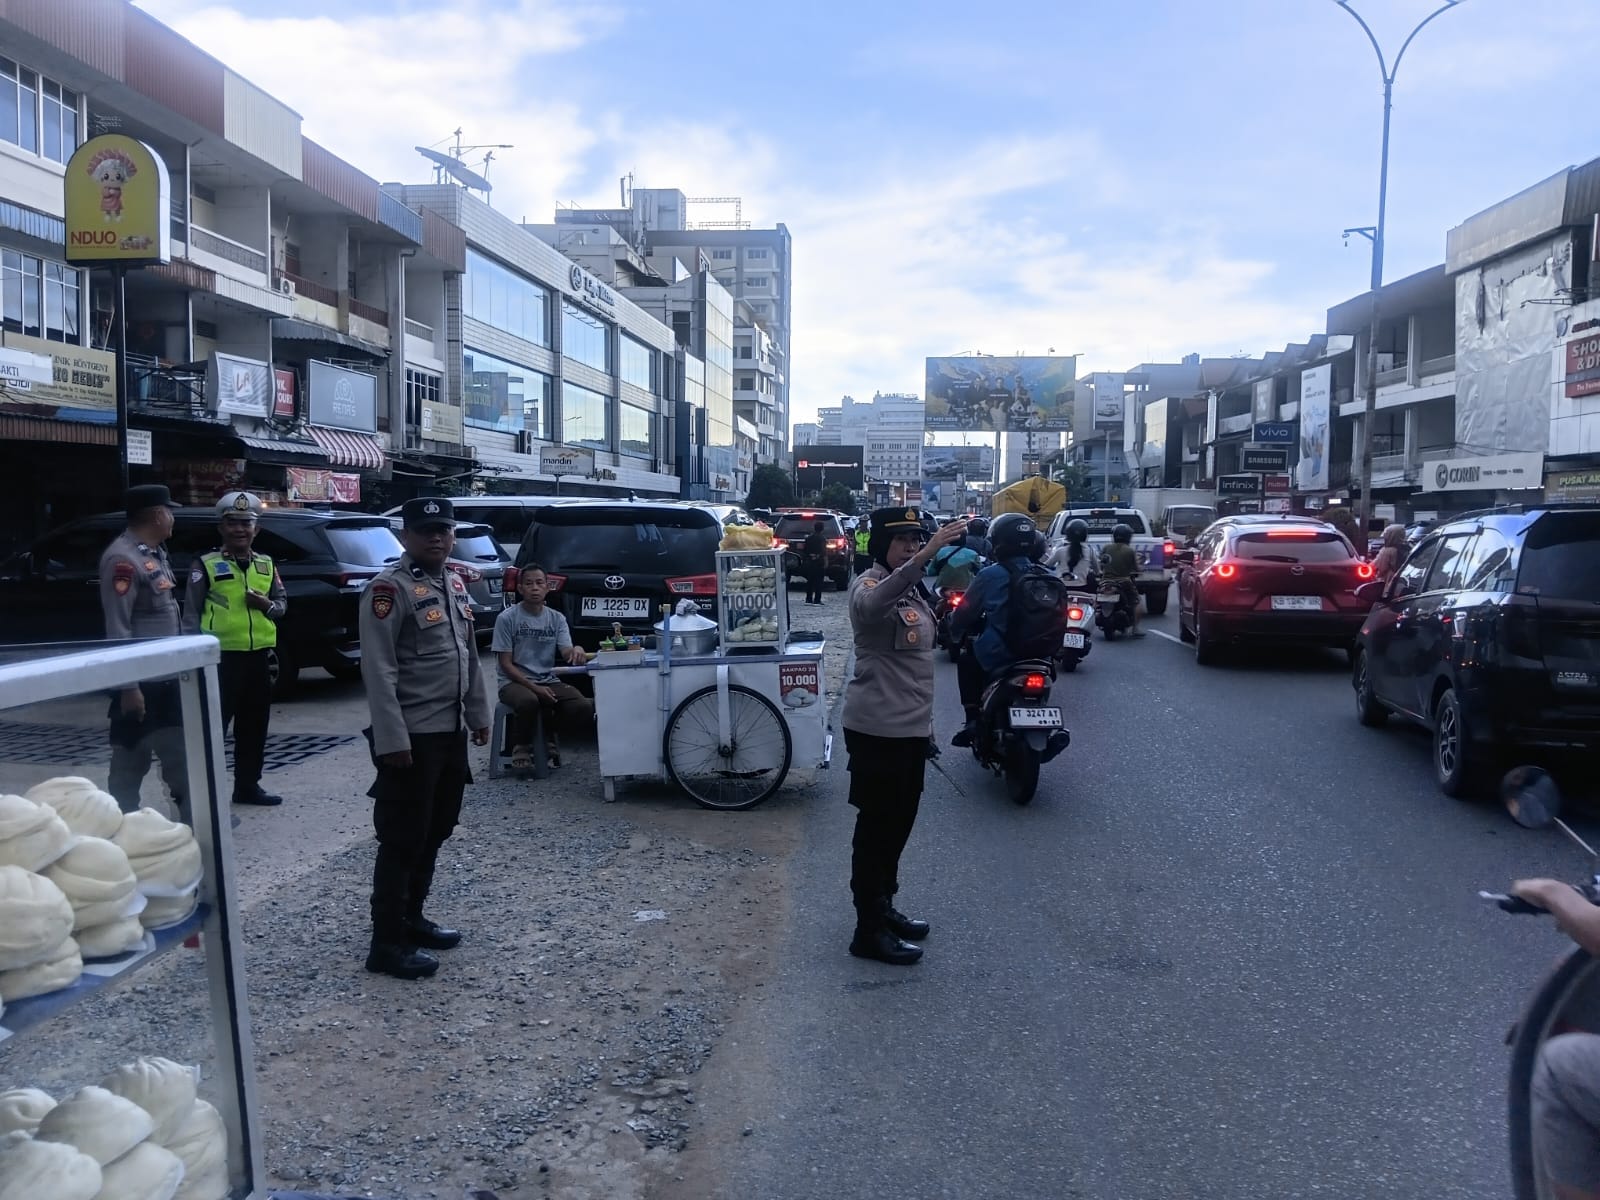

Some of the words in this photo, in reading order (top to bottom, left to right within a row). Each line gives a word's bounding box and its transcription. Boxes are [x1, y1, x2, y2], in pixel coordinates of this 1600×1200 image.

[71, 231, 117, 245] NDUO
[1572, 340, 1600, 357] SHO
[1259, 427, 1289, 436] vivo
[543, 457, 572, 465] mandiri
[1449, 466, 1480, 483] CORIN
[1222, 481, 1255, 489] infinix
[583, 599, 597, 610] KB
[602, 599, 630, 611] 1225
[782, 674, 816, 686] 10.000
